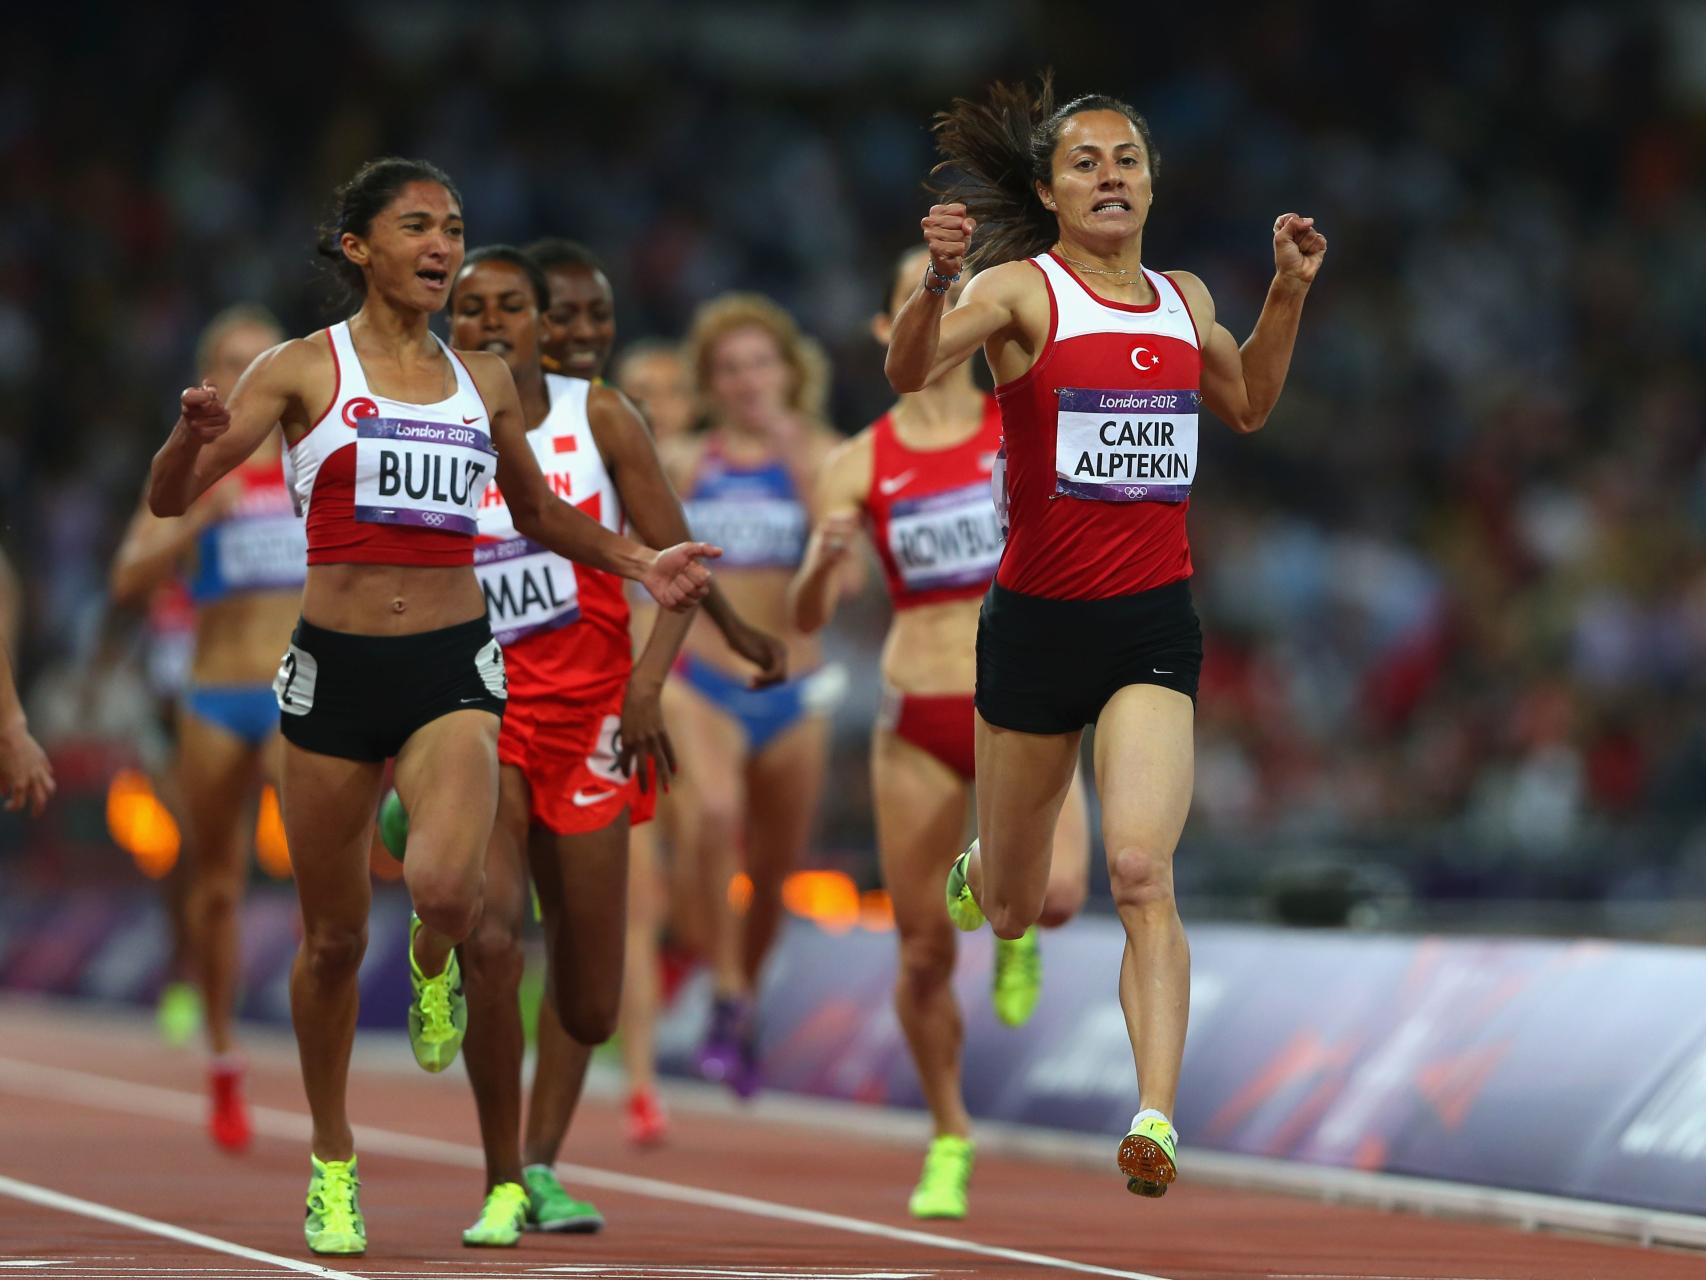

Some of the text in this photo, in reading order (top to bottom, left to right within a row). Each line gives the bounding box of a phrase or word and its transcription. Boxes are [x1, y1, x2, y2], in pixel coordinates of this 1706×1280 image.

[1099, 394, 1178, 409] London 2012
[396, 423, 476, 444] London 2012
[1099, 420, 1175, 446] CAKIR
[1074, 451, 1189, 478] ALPTEKIN
[379, 449, 486, 508] BULUT
[482, 565, 568, 622] MAL
